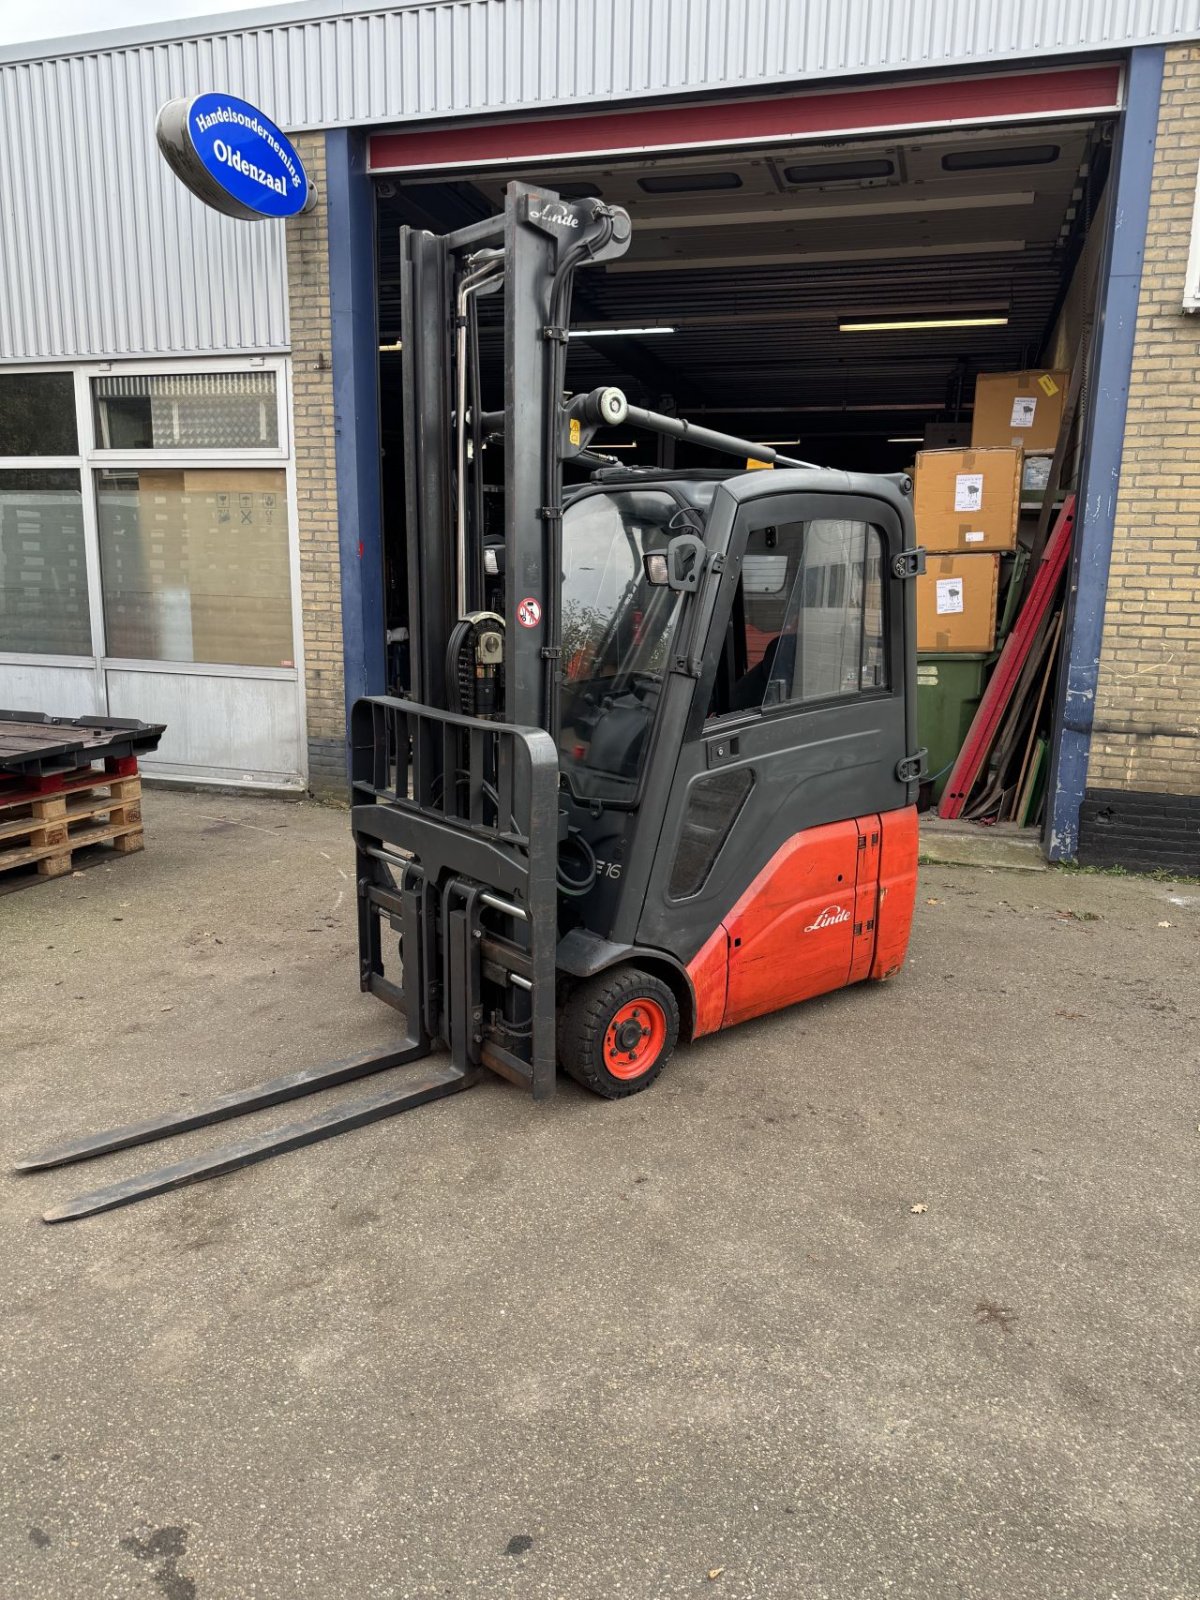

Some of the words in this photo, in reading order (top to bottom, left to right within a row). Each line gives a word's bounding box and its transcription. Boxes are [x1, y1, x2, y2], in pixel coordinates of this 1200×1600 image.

[196, 106, 301, 188] Handelsonderneming
[213, 139, 287, 196] Oldenzaal
[804, 905, 851, 932] Linde
